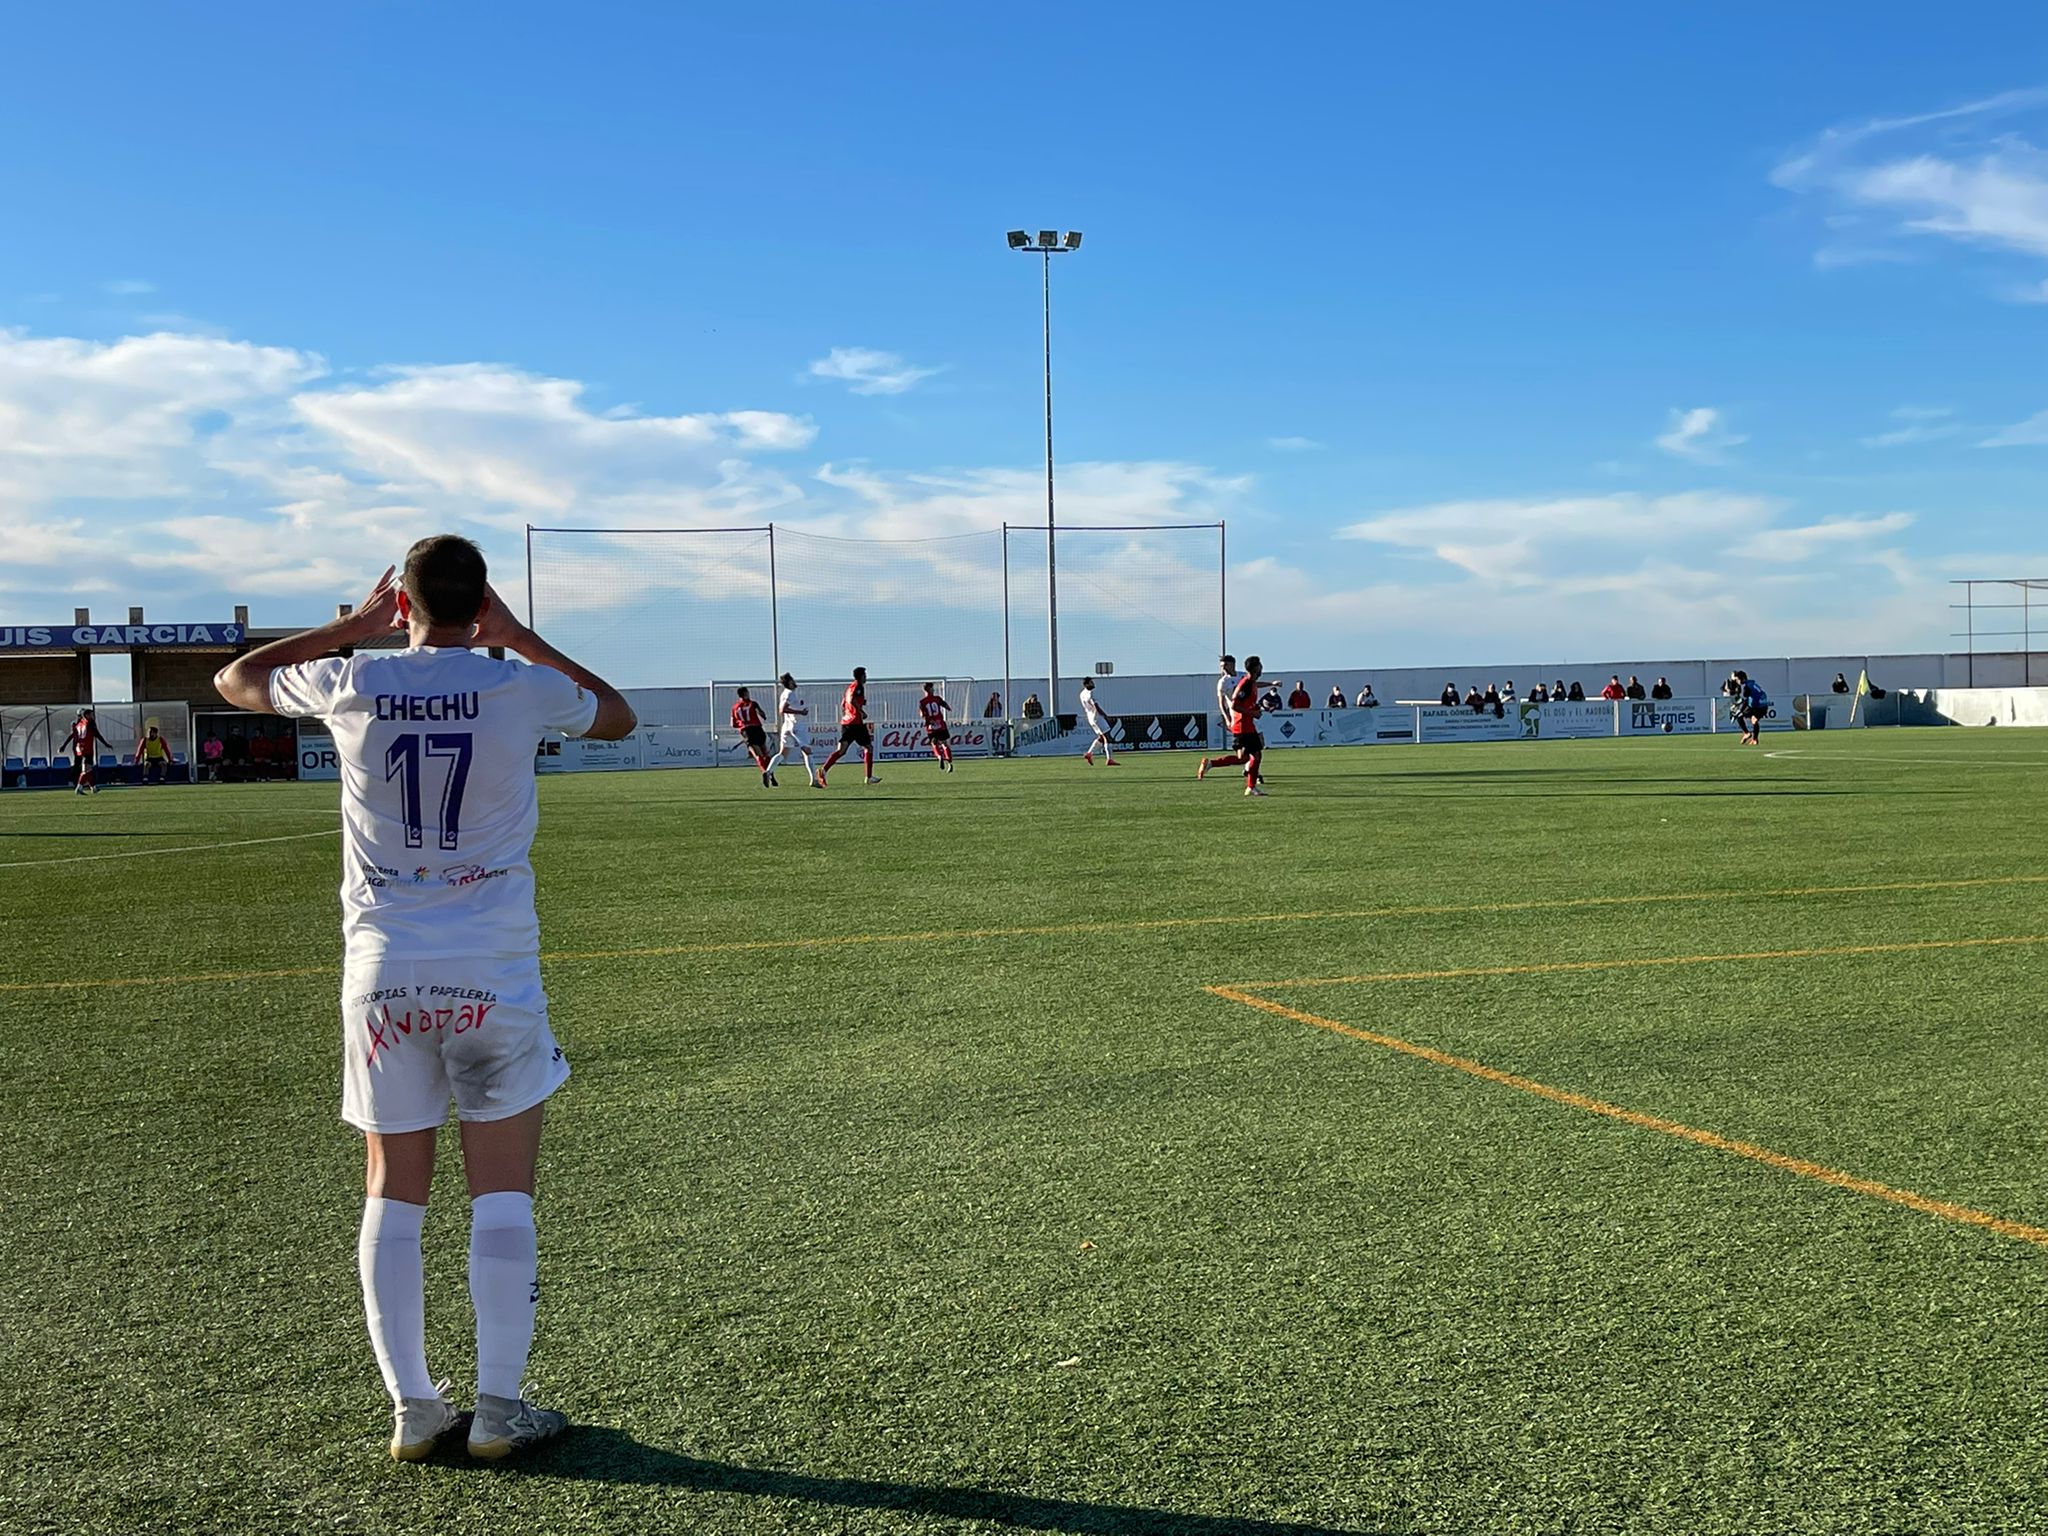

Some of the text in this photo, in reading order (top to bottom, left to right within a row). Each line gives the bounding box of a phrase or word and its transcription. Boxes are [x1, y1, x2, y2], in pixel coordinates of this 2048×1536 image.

[72, 625, 213, 645] GARCIA
[375, 691, 479, 721] CHECHU
[925, 702, 939, 717] 19
[385, 732, 473, 851] 17
[415, 986, 425, 996] Y
[430, 986, 497, 1003] PAPELERÍA
